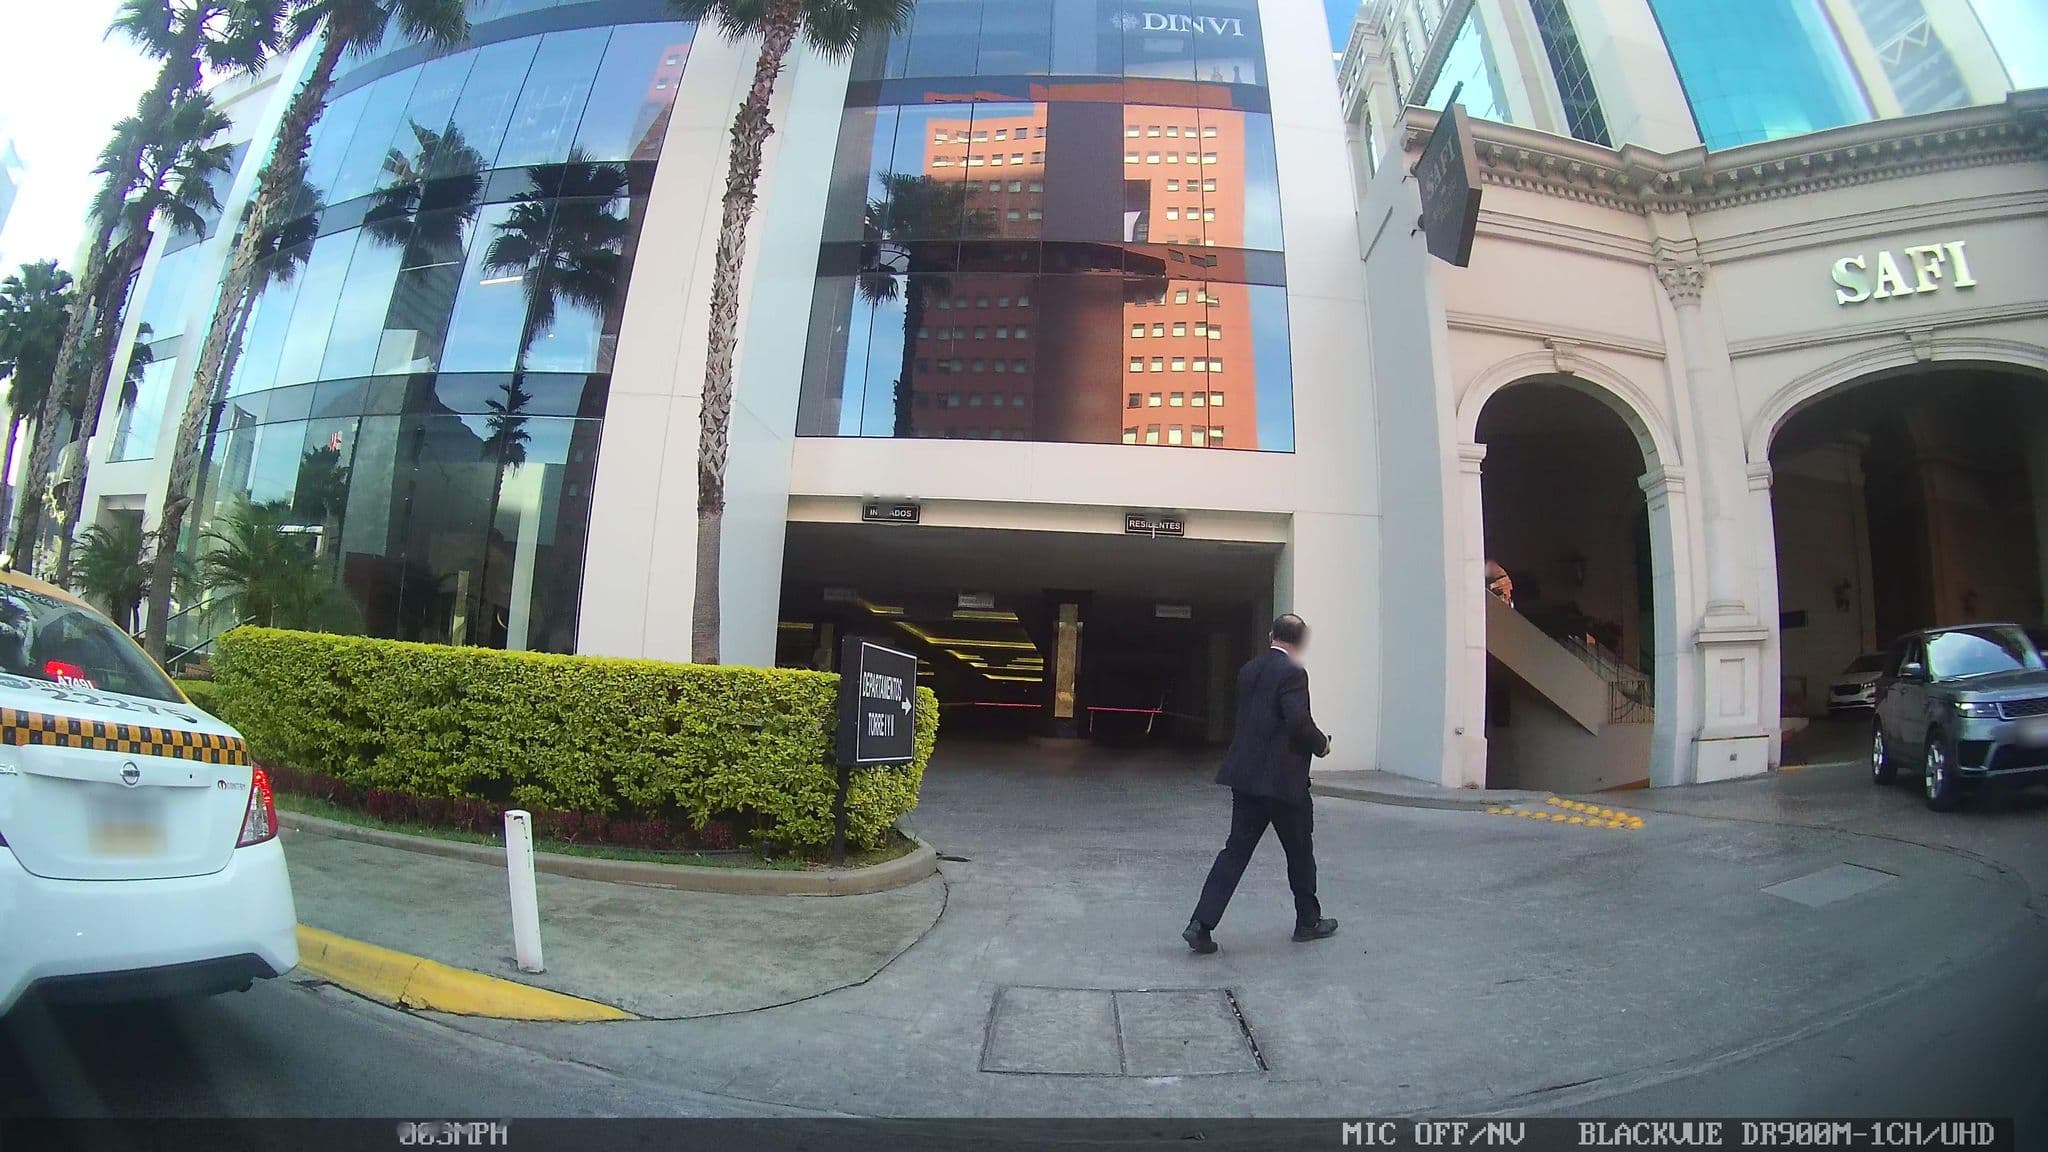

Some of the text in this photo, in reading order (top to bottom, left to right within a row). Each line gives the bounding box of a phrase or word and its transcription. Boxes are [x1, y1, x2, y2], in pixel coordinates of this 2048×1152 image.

[1142, 12, 1244, 37] DINVI
[1831, 240, 1978, 306] SAFI
[869, 508, 912, 518] INADOS
[862, 671, 903, 702] DEPARTAMENTOS
[868, 712, 884, 737] TORRE
